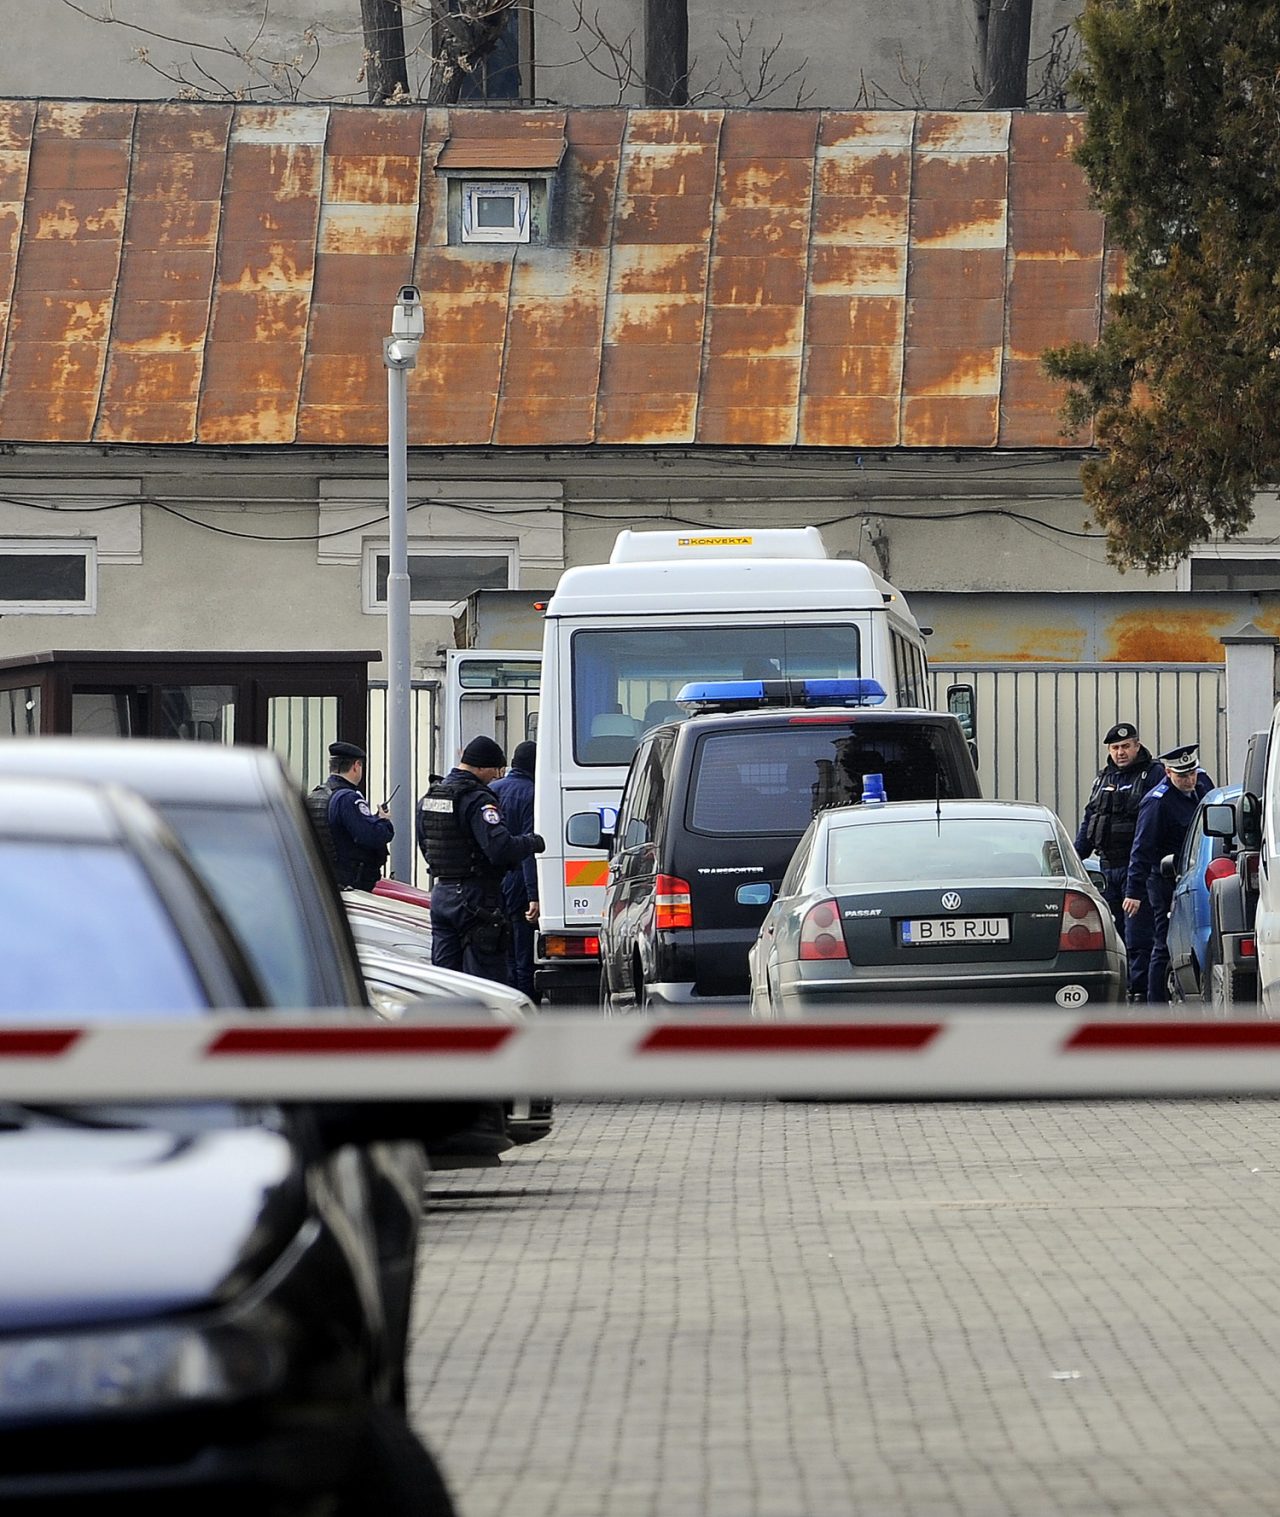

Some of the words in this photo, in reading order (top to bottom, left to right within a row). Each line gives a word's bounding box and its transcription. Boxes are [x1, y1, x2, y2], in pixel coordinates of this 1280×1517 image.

[690, 537, 749, 545] KONVEKTA
[844, 909, 882, 917] PASSAT
[920, 922, 932, 938] B
[940, 922, 956, 937] 15
[964, 920, 999, 937] RJU
[1064, 992, 1081, 1002] RO
